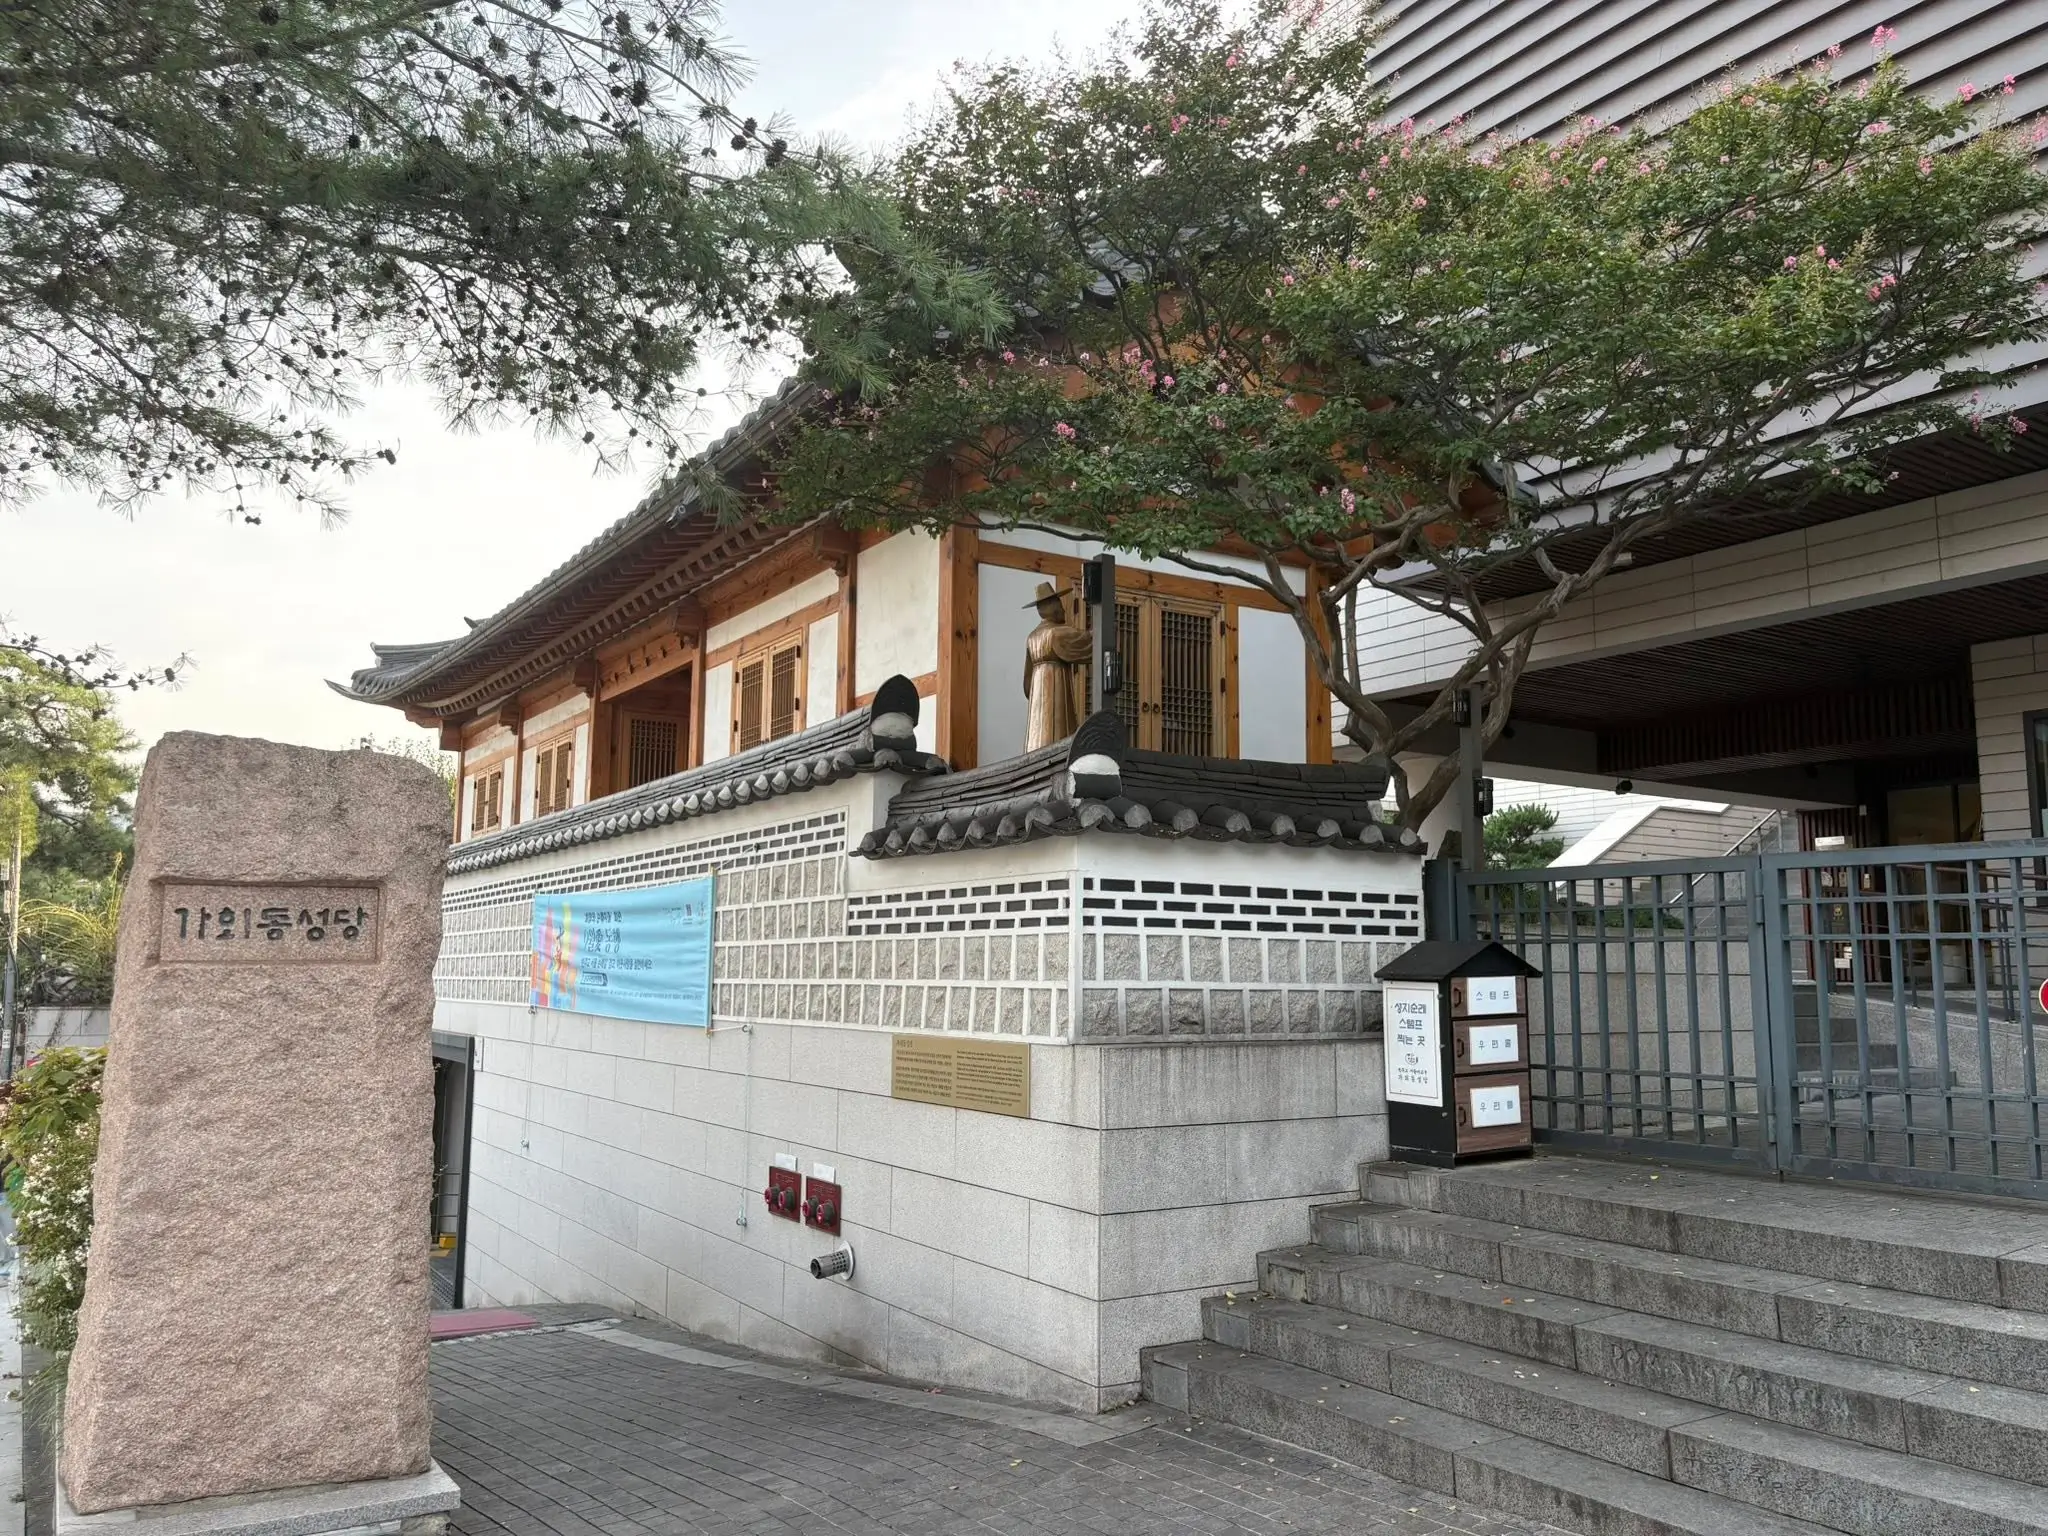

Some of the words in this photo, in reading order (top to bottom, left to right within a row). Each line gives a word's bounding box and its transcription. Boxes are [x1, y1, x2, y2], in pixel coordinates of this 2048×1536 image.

[174, 906, 369, 941] 가회동성당
[1394, 1002, 1427, 1014] 성지순례
[1396, 1033, 1413, 1046] 찍는
[1417, 1035, 1425, 1046] 곳
